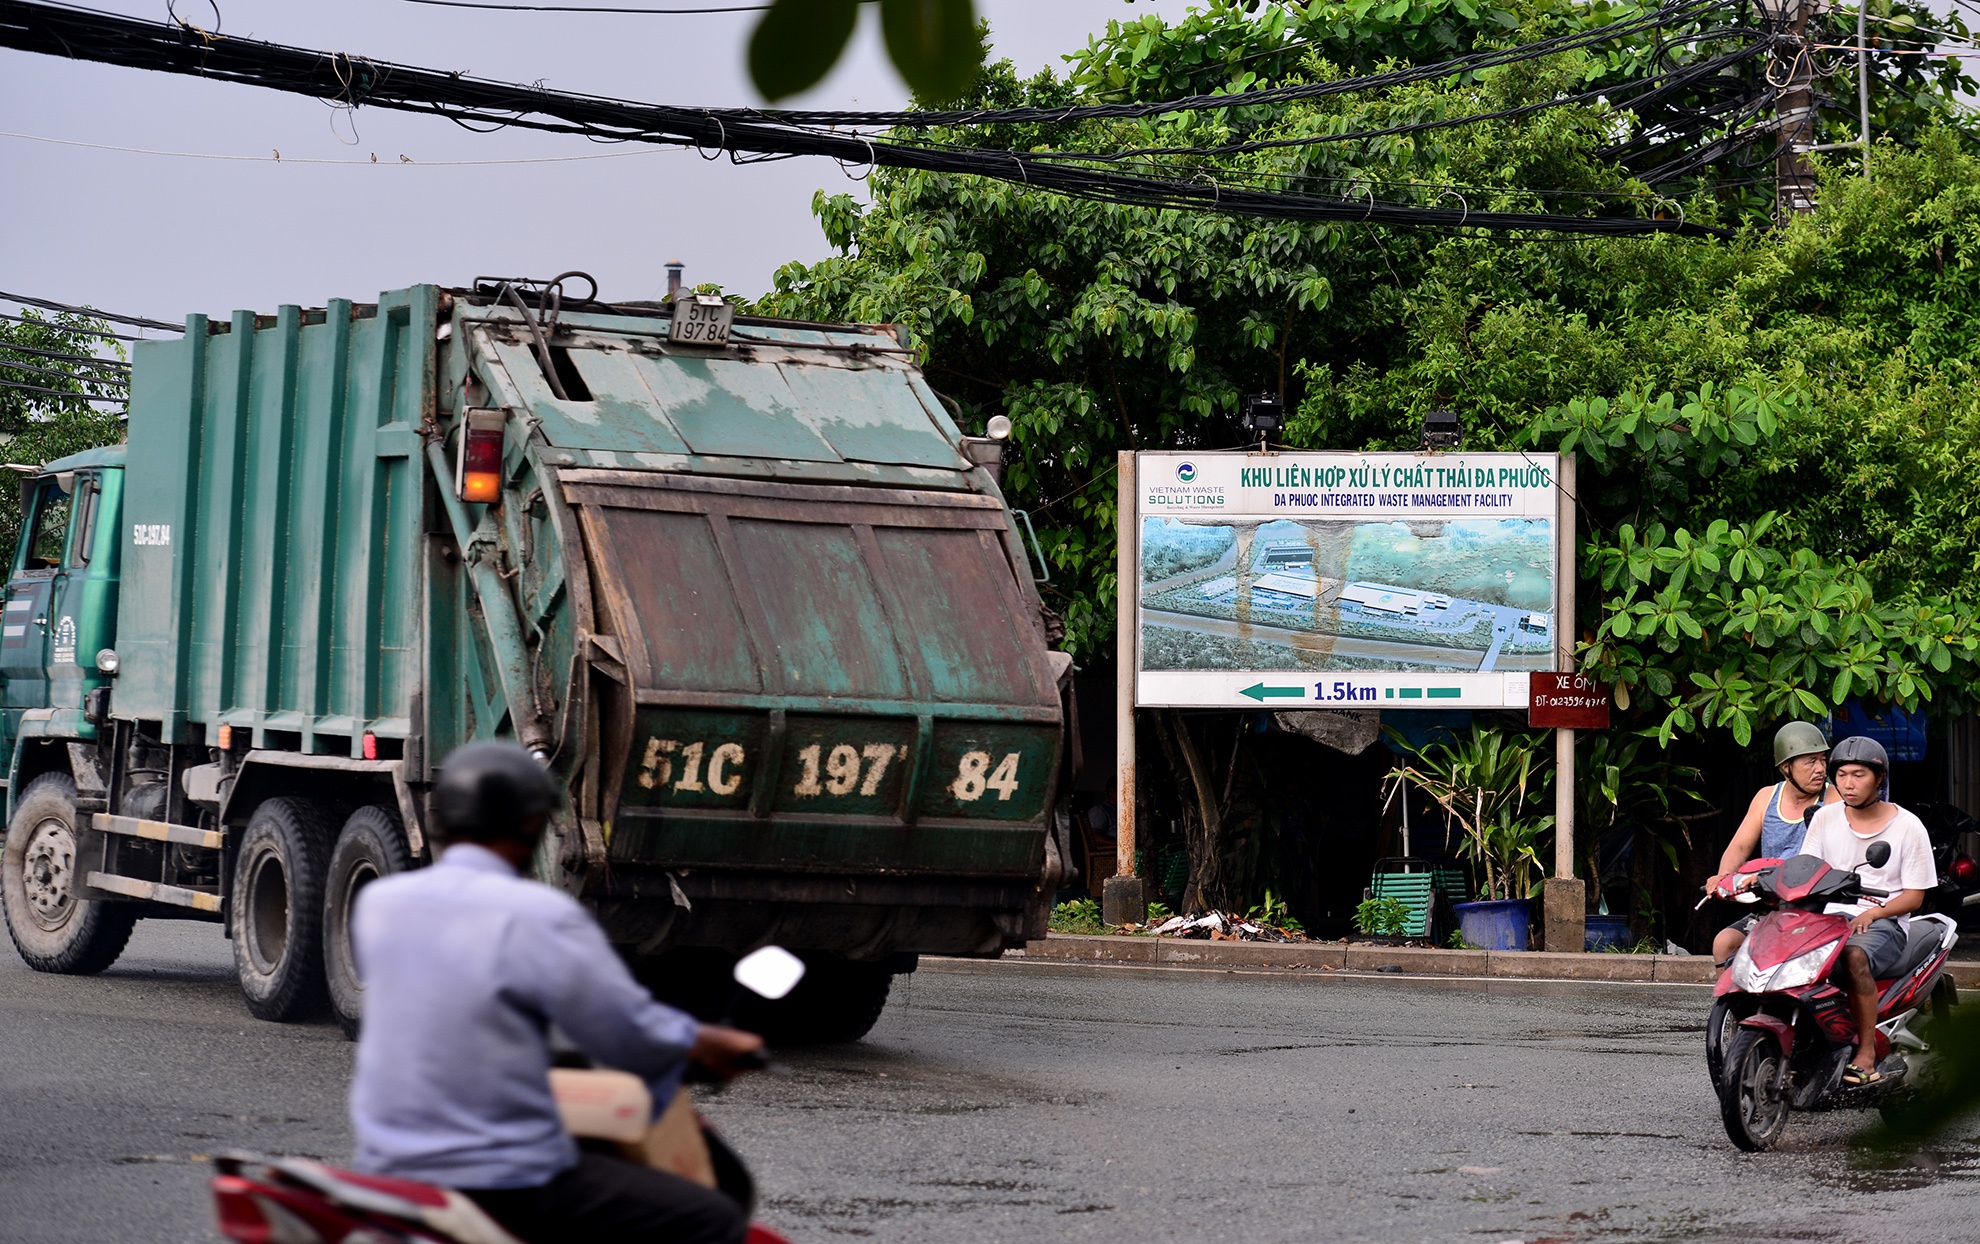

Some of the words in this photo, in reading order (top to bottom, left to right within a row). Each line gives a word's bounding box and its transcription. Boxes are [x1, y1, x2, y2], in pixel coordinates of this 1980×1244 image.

[675, 321, 726, 342] 197.84
[1241, 467, 1272, 488] KHU
[1277, 463, 1311, 488] LIÊN
[1315, 466, 1346, 492] HỢP
[1348, 459, 1371, 488] XỬ
[1373, 463, 1391, 488] LÝ
[1393, 461, 1434, 488] CHẤT
[1436, 460, 1472, 488] THẢI
[1475, 468, 1495, 488] ĐA
[1500, 462, 1550, 488] PHƯỚC
[1148, 495, 1225, 504] SOLUTIONS
[1149, 486, 1190, 494] VIETNAM
[1192, 486, 1225, 494] WASTE
[1274, 494, 1287, 507] DA
[1289, 494, 1318, 507] PHUOC
[1321, 494, 1375, 507] INTEGRATED
[1379, 494, 1408, 507] WASTE
[1412, 494, 1471, 507] MANAGEMENT
[1475, 494, 1512, 507] FACILITY
[1313, 682, 1377, 701] 1.5km
[1556, 675, 1570, 689] XE
[1574, 673, 1597, 693] ÔM
[637, 735, 745, 796] 51C
[950, 750, 1020, 802] 84
